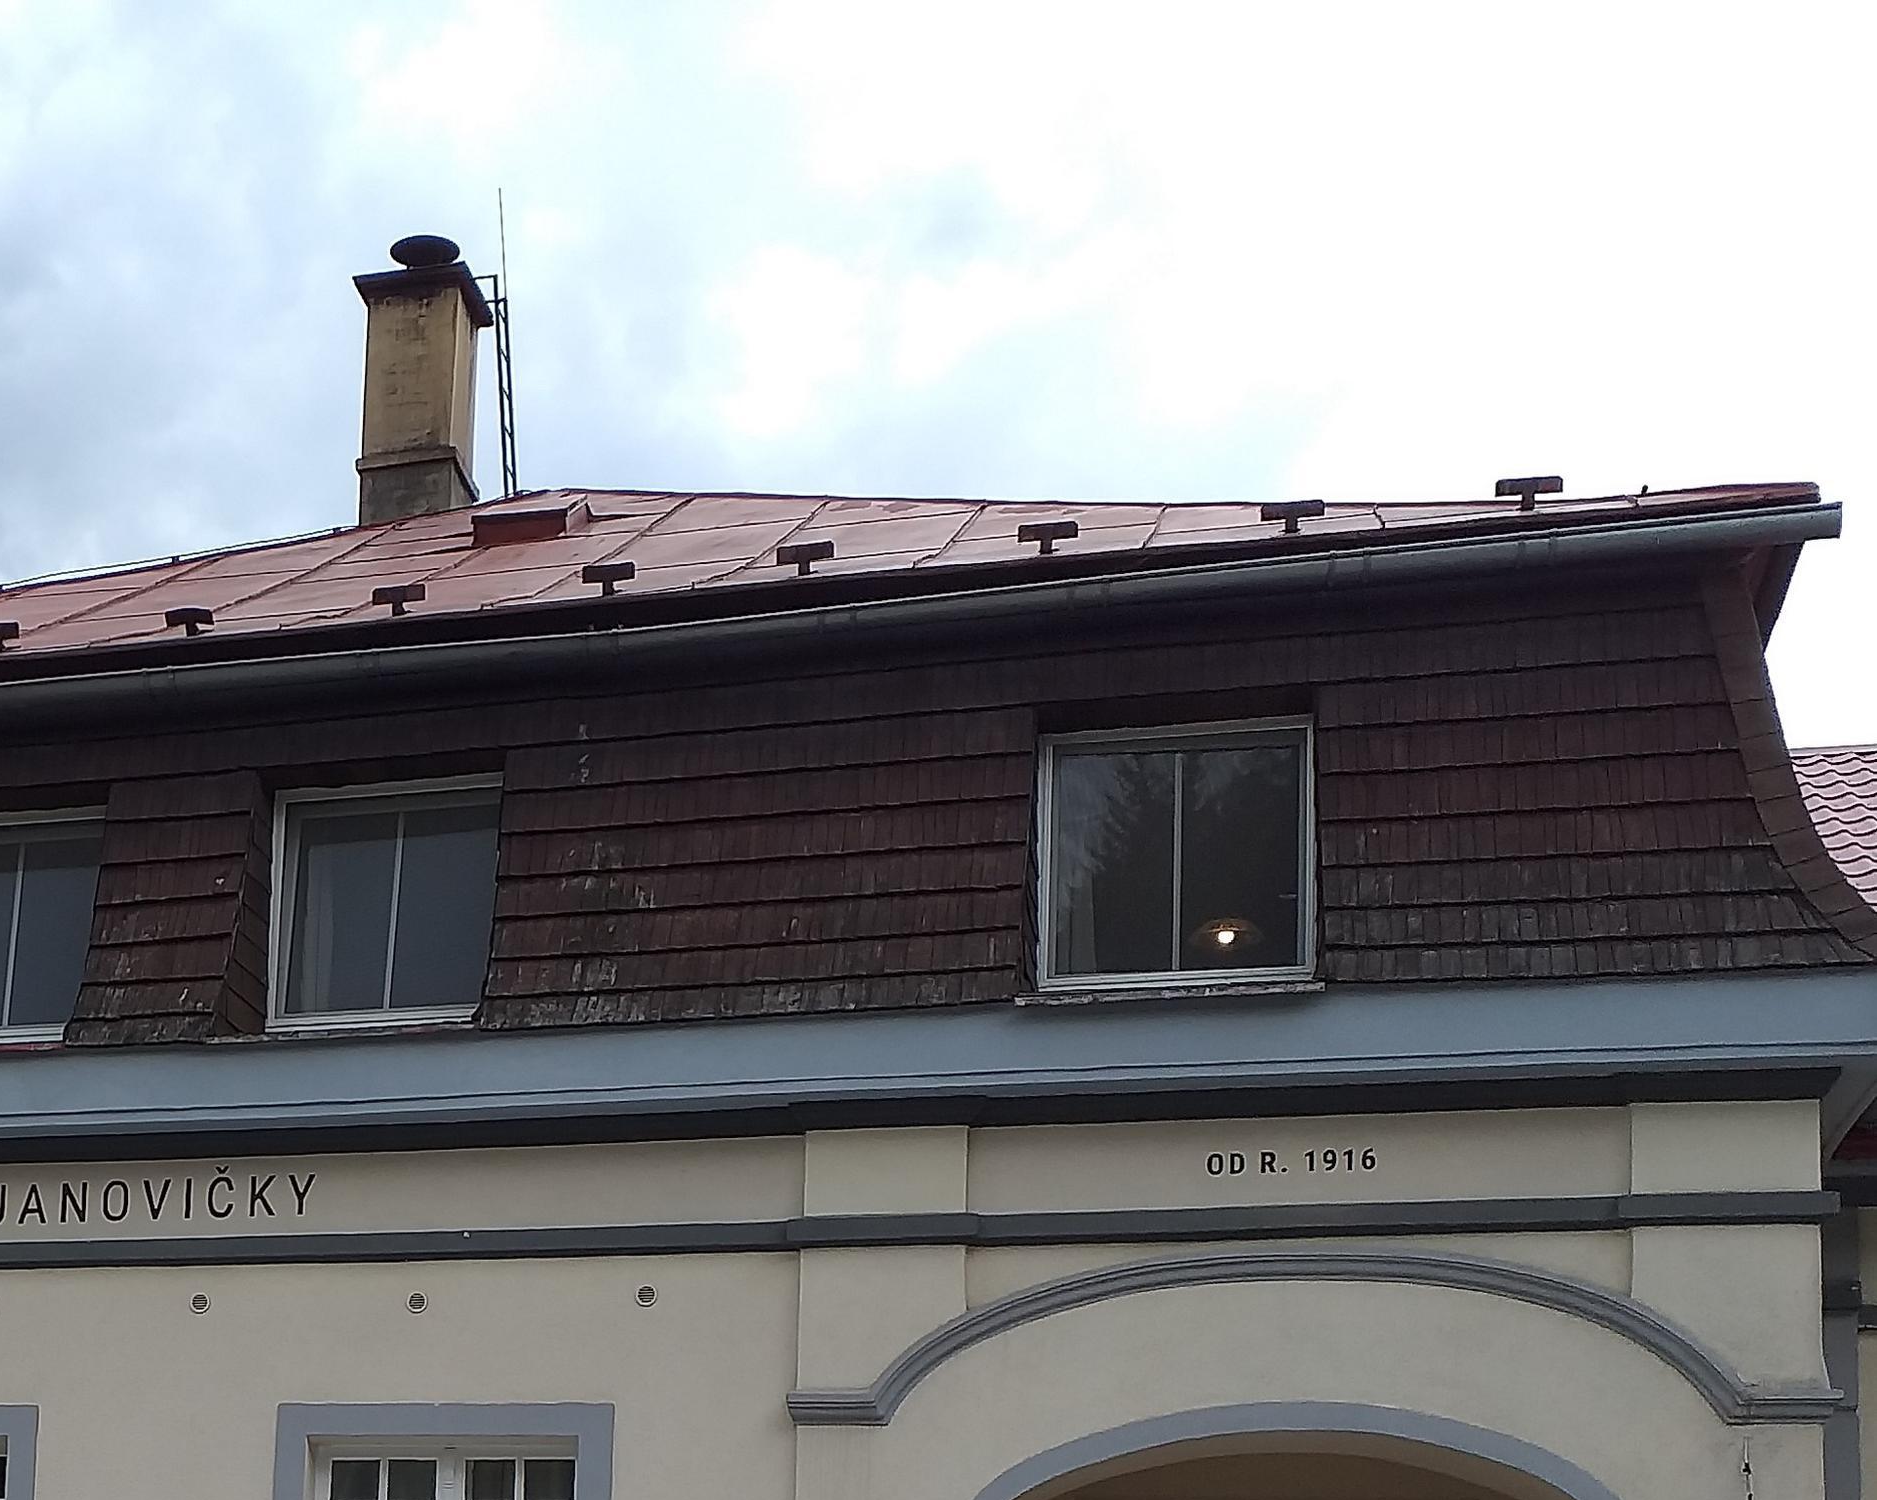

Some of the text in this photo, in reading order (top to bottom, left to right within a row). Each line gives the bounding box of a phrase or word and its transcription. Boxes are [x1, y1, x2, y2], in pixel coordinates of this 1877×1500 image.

[1206, 1147, 1376, 1176] OD R. 1916
